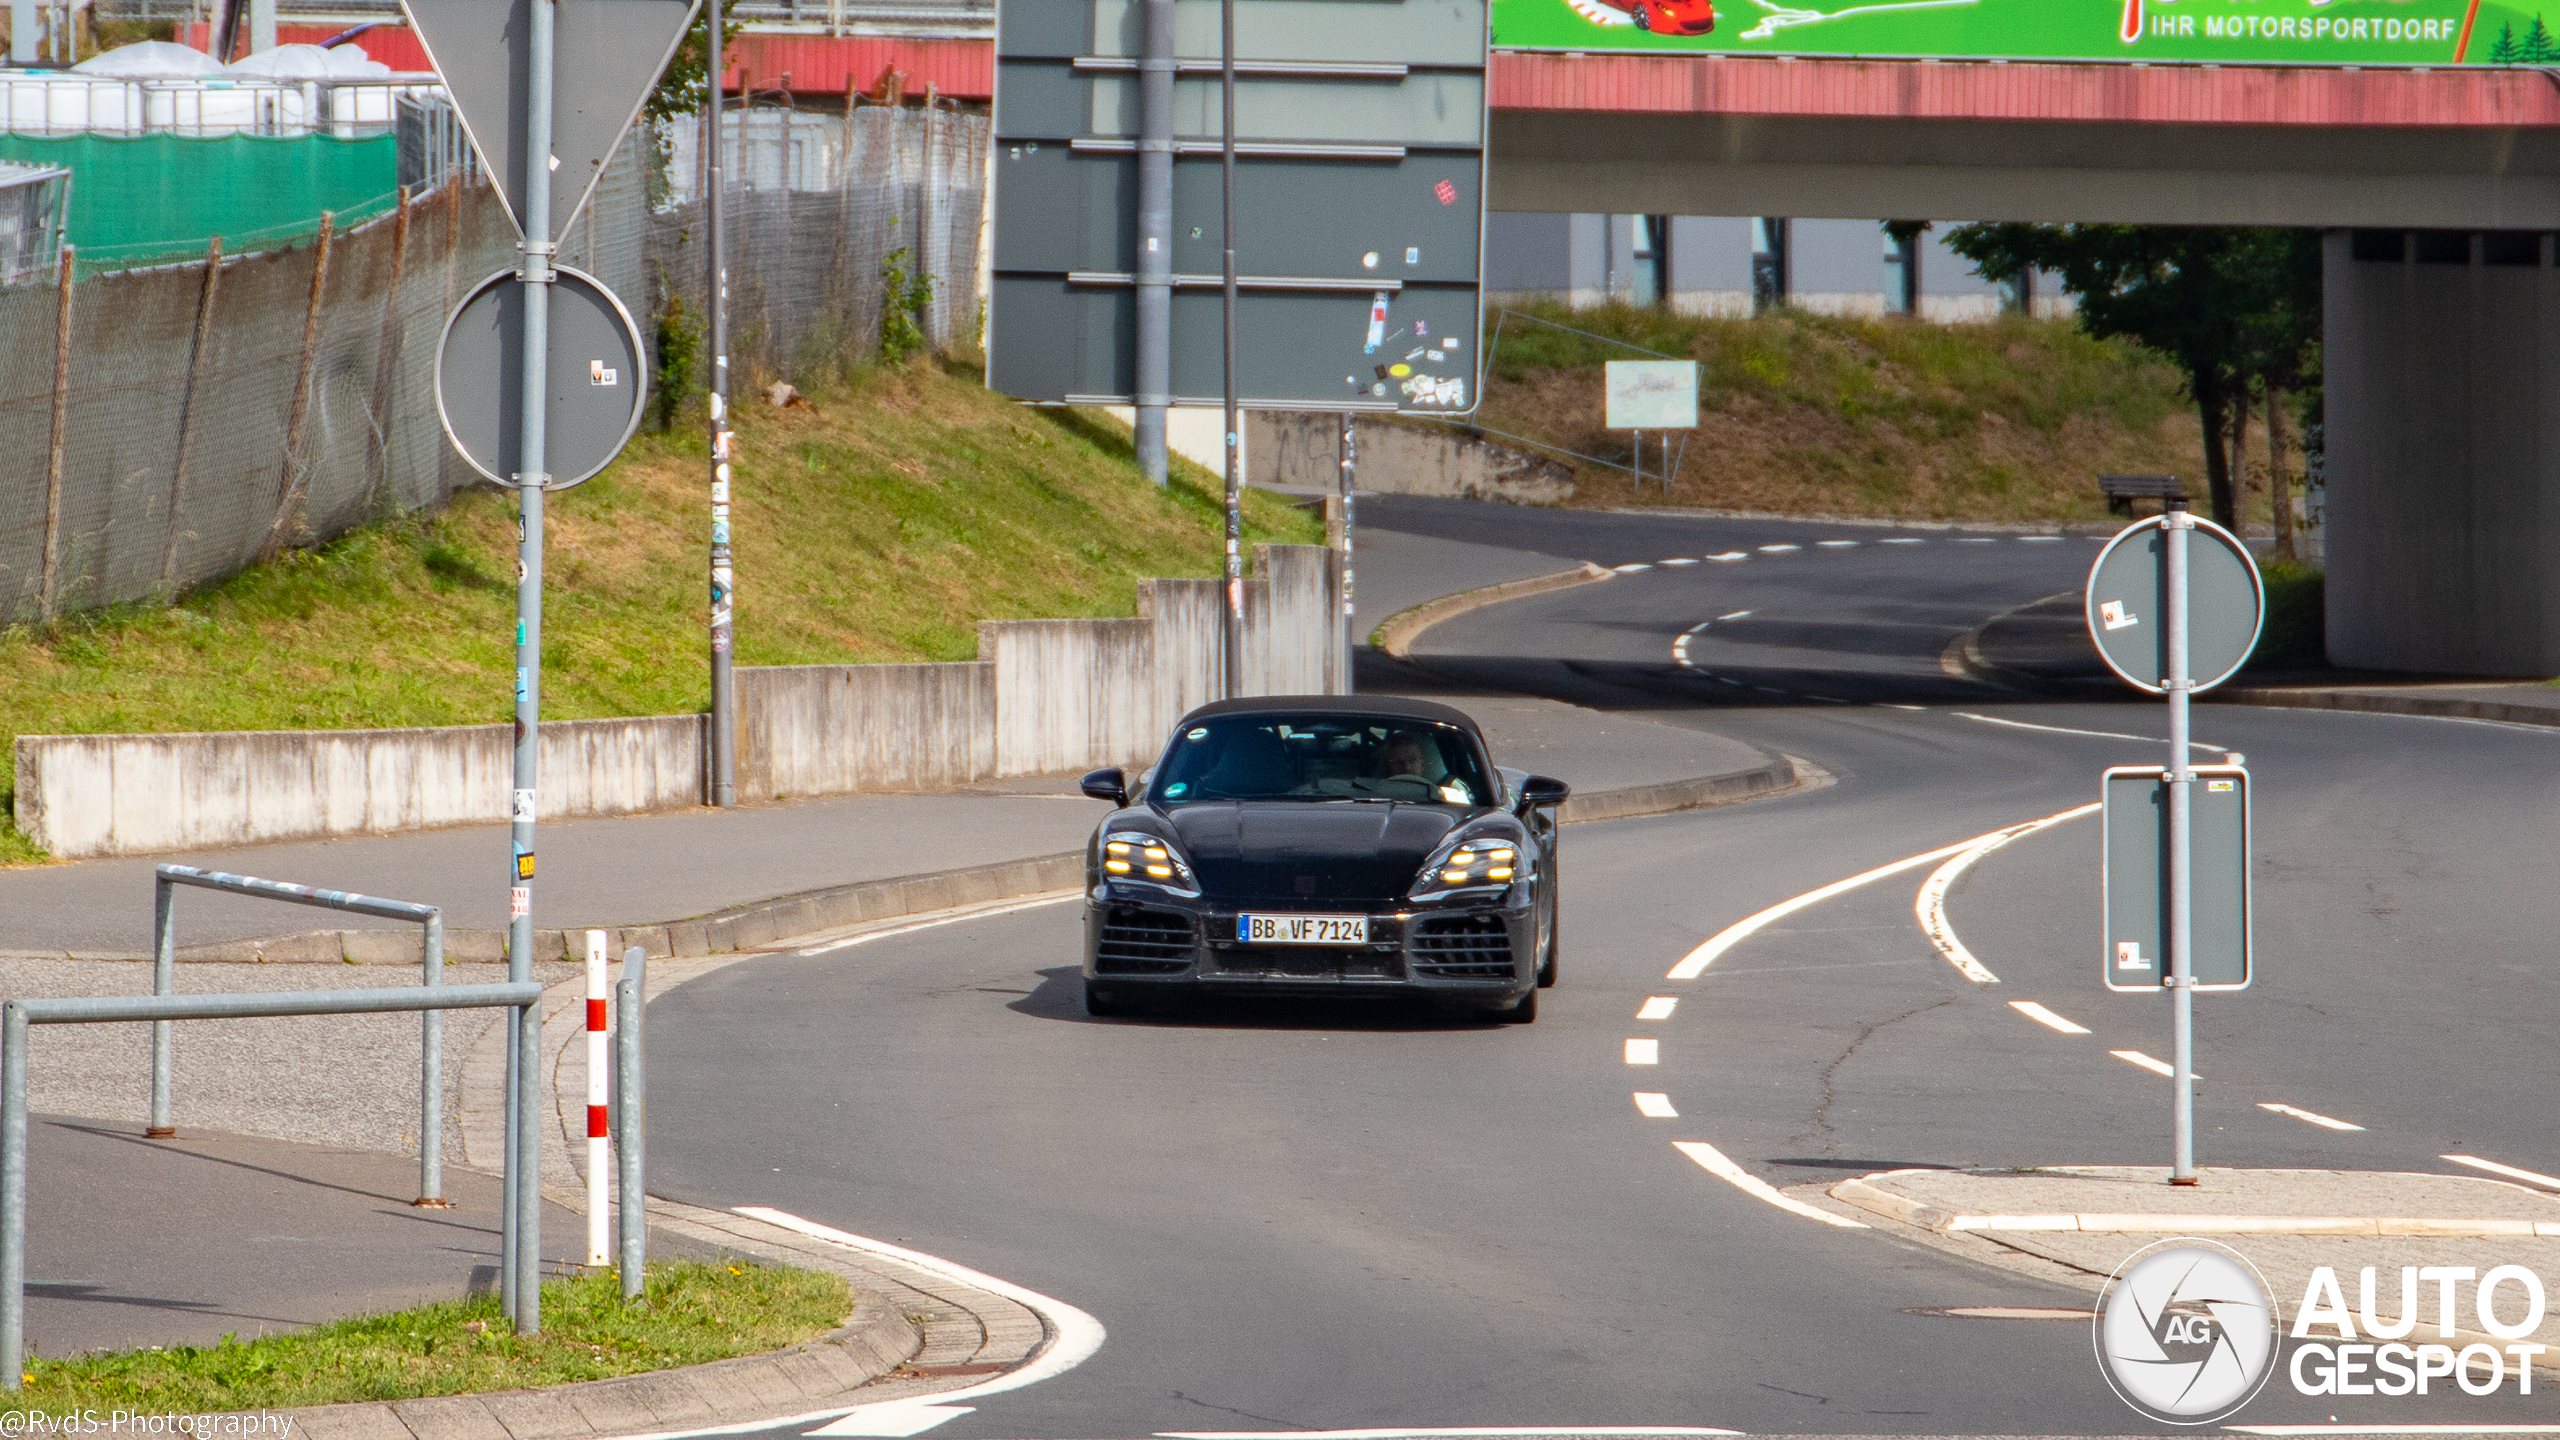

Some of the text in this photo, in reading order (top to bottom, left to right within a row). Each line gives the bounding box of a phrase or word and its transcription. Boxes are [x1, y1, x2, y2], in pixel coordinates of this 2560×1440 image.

[2152, 14, 2457, 40] IHR MOTORSPORTDORF
[1252, 918, 1276, 939] BB
[1290, 918, 1314, 940] VF
[1318, 919, 1365, 941] 7124
